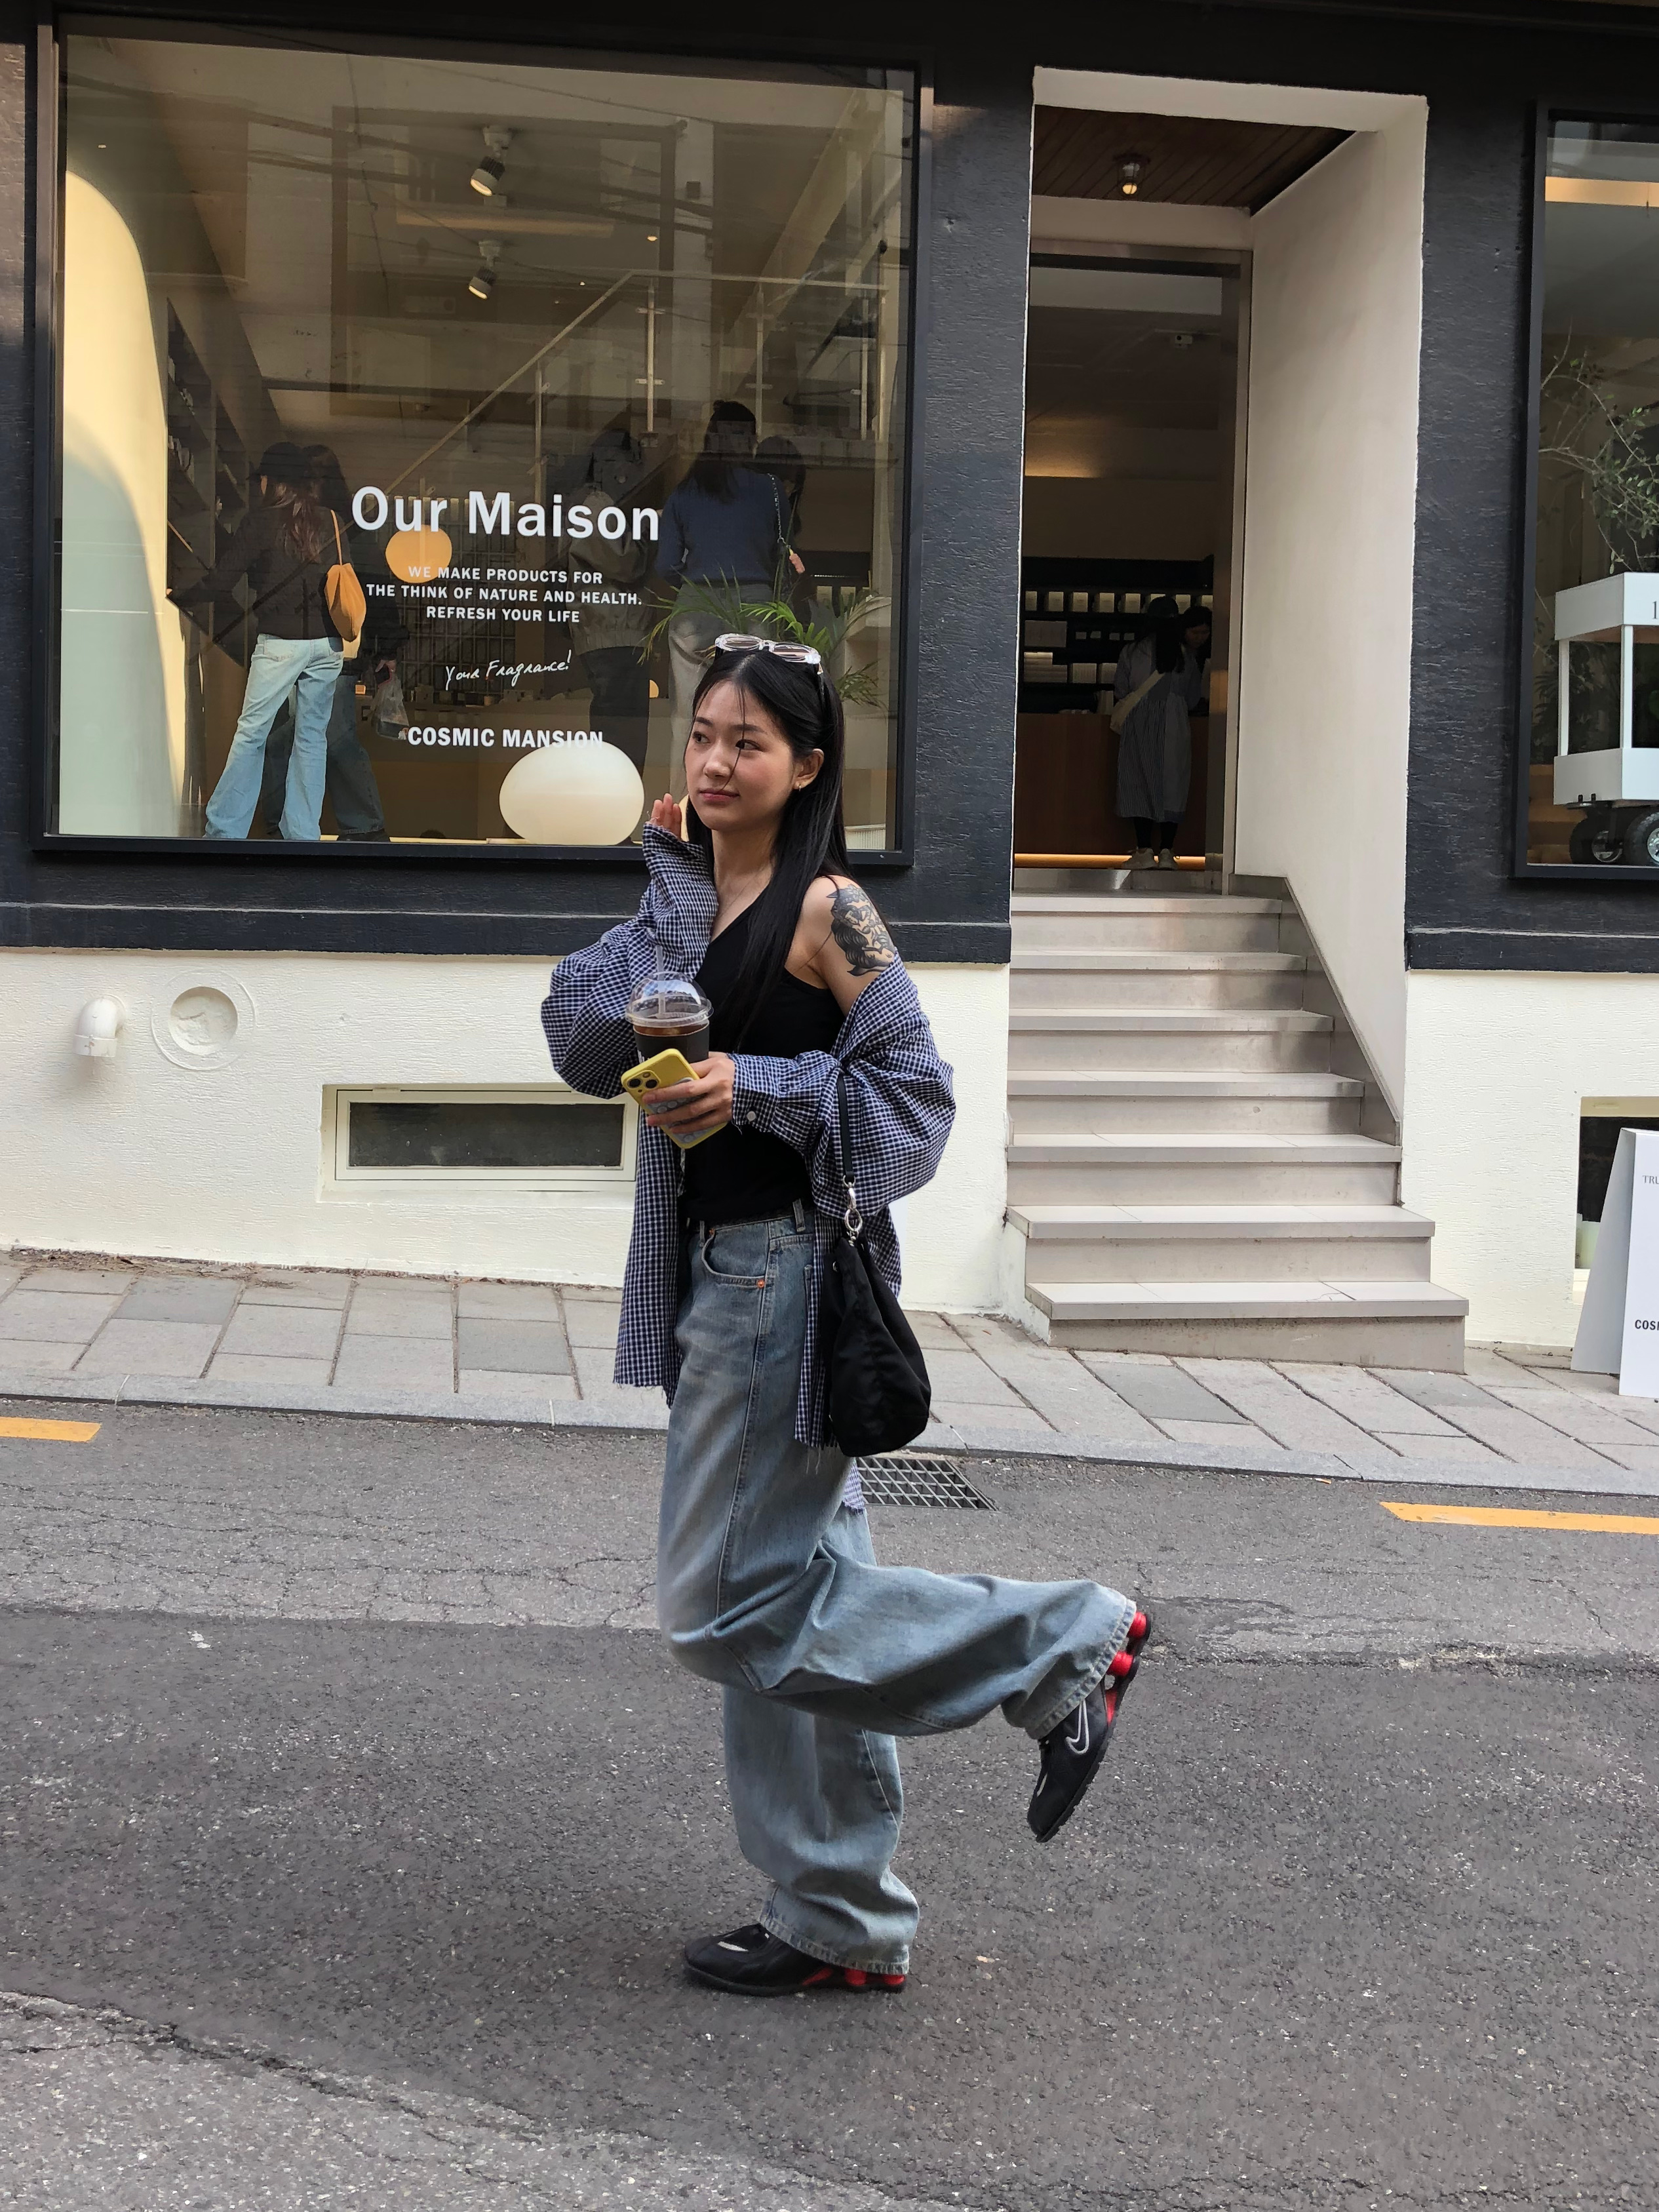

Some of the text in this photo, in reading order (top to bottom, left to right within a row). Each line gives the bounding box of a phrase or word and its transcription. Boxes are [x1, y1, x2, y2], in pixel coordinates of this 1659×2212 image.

[353, 486, 658, 540] Our Maison
[408, 566, 602, 583] WE MAKE PRODUCTS FOR
[366, 584, 641, 604] THE THINK OF NATURE AND HEALTH.
[427, 606, 579, 622] REFRESH YOUR LIFE
[446, 650, 571, 690] Your Fragrance!
[408, 727, 602, 749] COSMIC MANSION
[1635, 1319, 1659, 1331] COS
